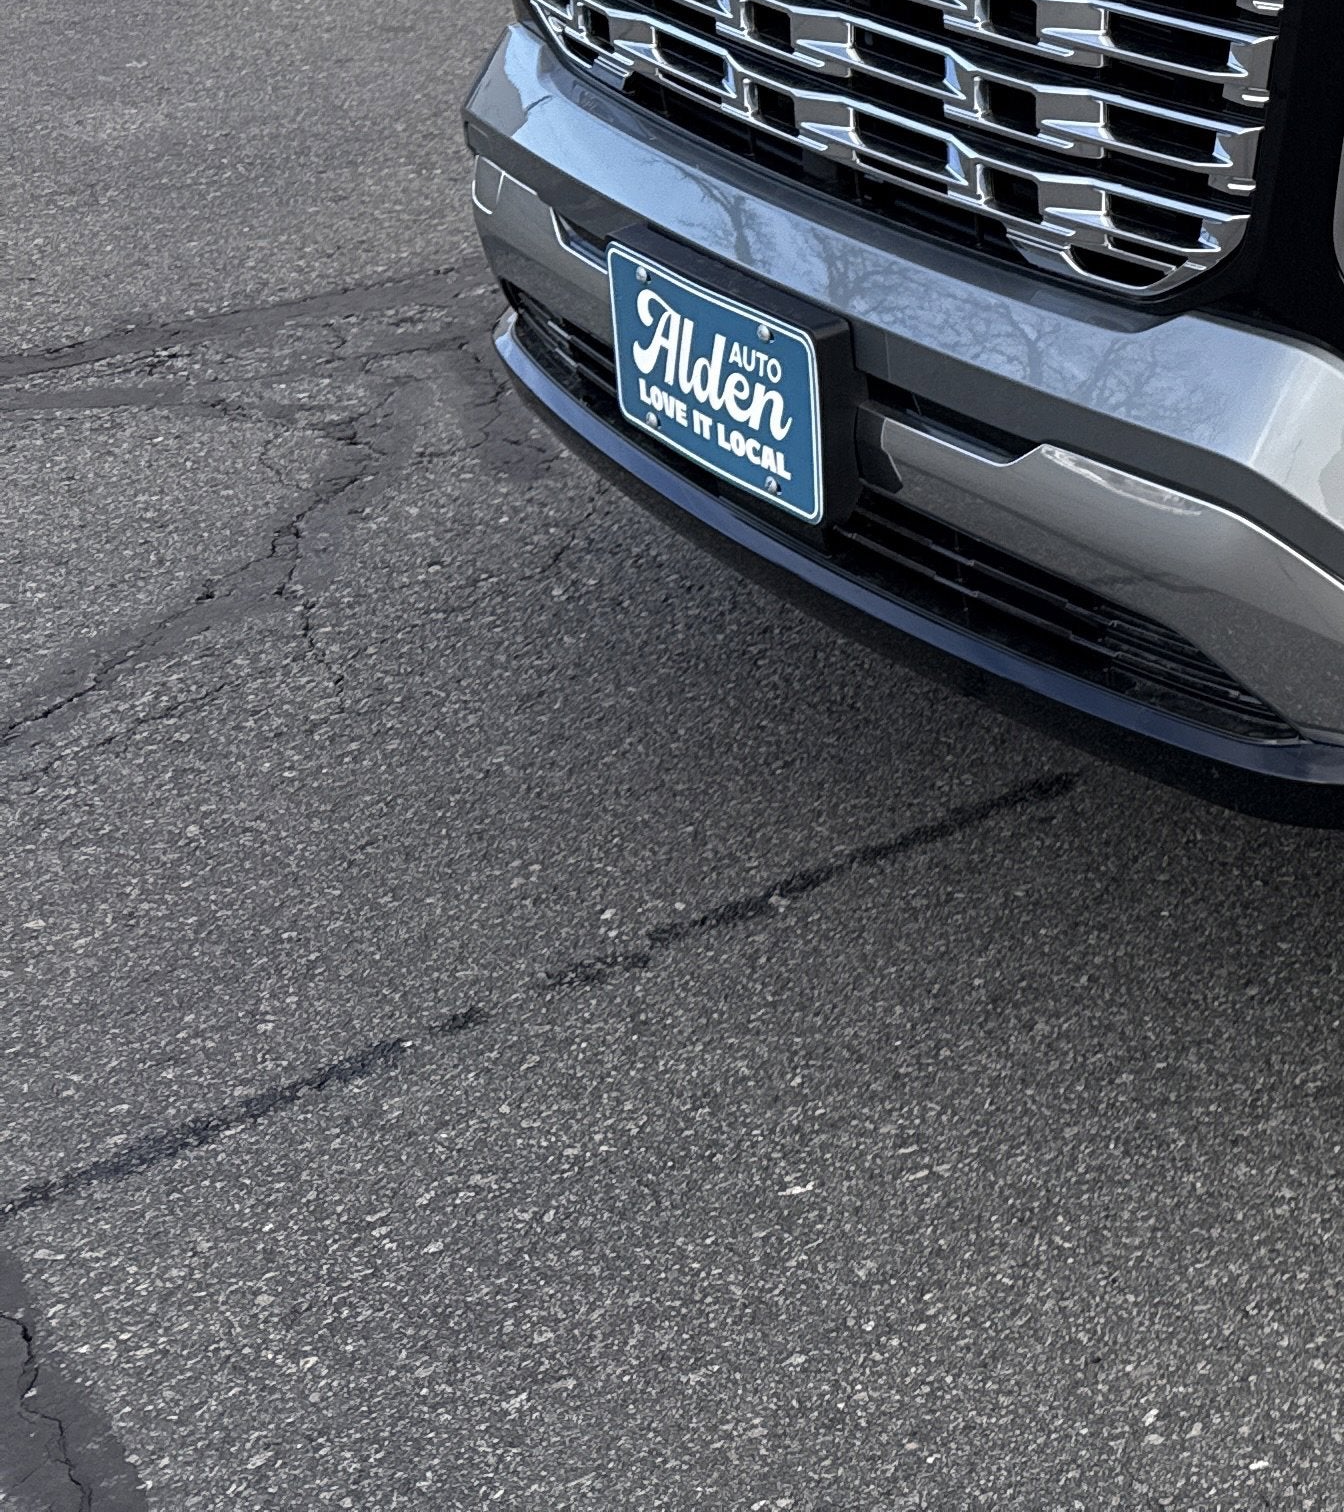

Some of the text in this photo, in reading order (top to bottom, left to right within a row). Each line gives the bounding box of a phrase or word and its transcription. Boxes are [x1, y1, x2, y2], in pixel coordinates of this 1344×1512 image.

[632, 288, 793, 441] Alden
[727, 341, 783, 384] AUTO
[638, 377, 793, 481] LOVE IT LOCAL
